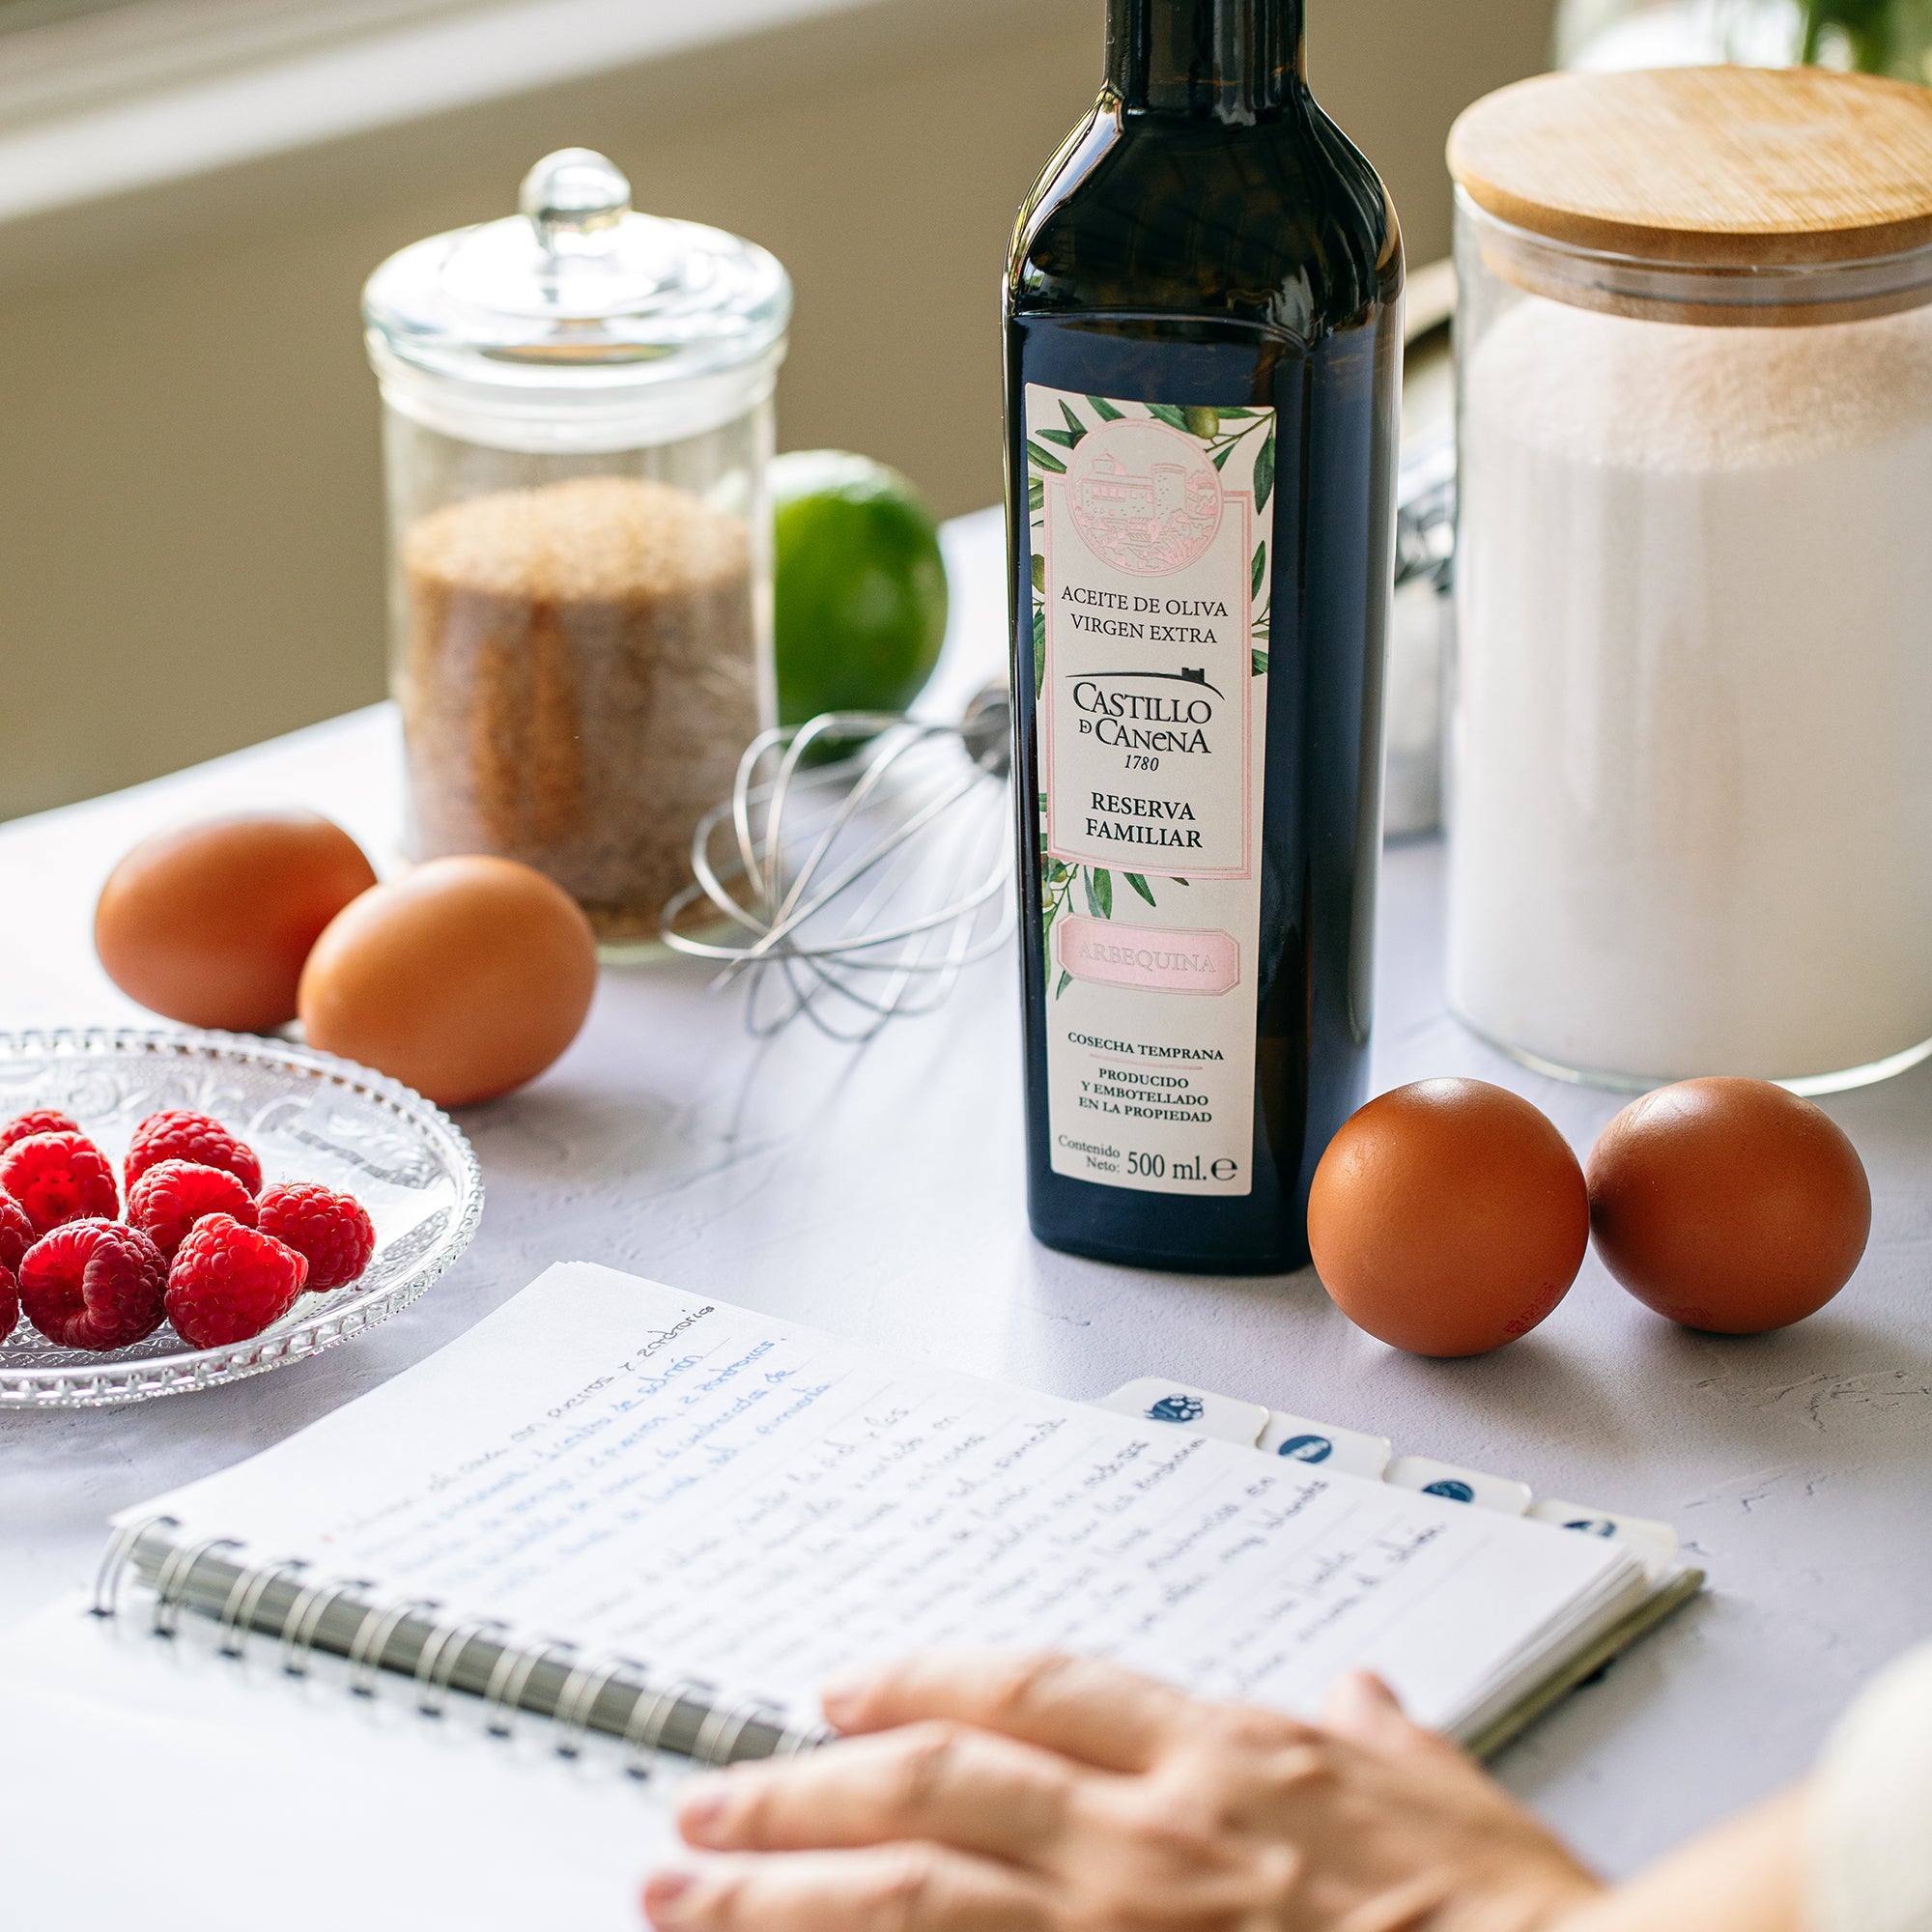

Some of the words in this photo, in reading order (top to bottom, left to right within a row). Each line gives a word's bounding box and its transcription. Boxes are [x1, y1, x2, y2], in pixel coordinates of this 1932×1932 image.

[1061, 585, 1128, 610] ACEITE
[1132, 596, 1161, 613] DE
[1165, 599, 1229, 617] OLIVA
[1070, 612, 1144, 639] VIRGEN
[1150, 625, 1218, 643] EXTRA
[1073, 681, 1212, 724] CASTILLO
[1124, 754, 1159, 772] 1780
[1091, 791, 1196, 821] RESERVA
[1085, 817, 1204, 849] FAMILIAR
[1077, 942, 1217, 973] ARBEQUINA
[1067, 1032, 1134, 1054] COSECHA
[1138, 1044, 1225, 1061] TEMPRANA
[1098, 1067, 1189, 1089] PRODUCIDO
[1081, 1081, 1091, 1092] Y
[1094, 1083, 1209, 1106] EMBOTELLADO
[1078, 1096, 1099, 1110] EN
[1102, 1101, 1121, 1114] LA
[1124, 1105, 1213, 1122] PROPIEDAD
[1058, 1134, 1121, 1158] Contenido
[1086, 1155, 1121, 1174] Neto:
[1127, 1151, 1165, 1178] 500
[1172, 1155, 1208, 1180] ml.
